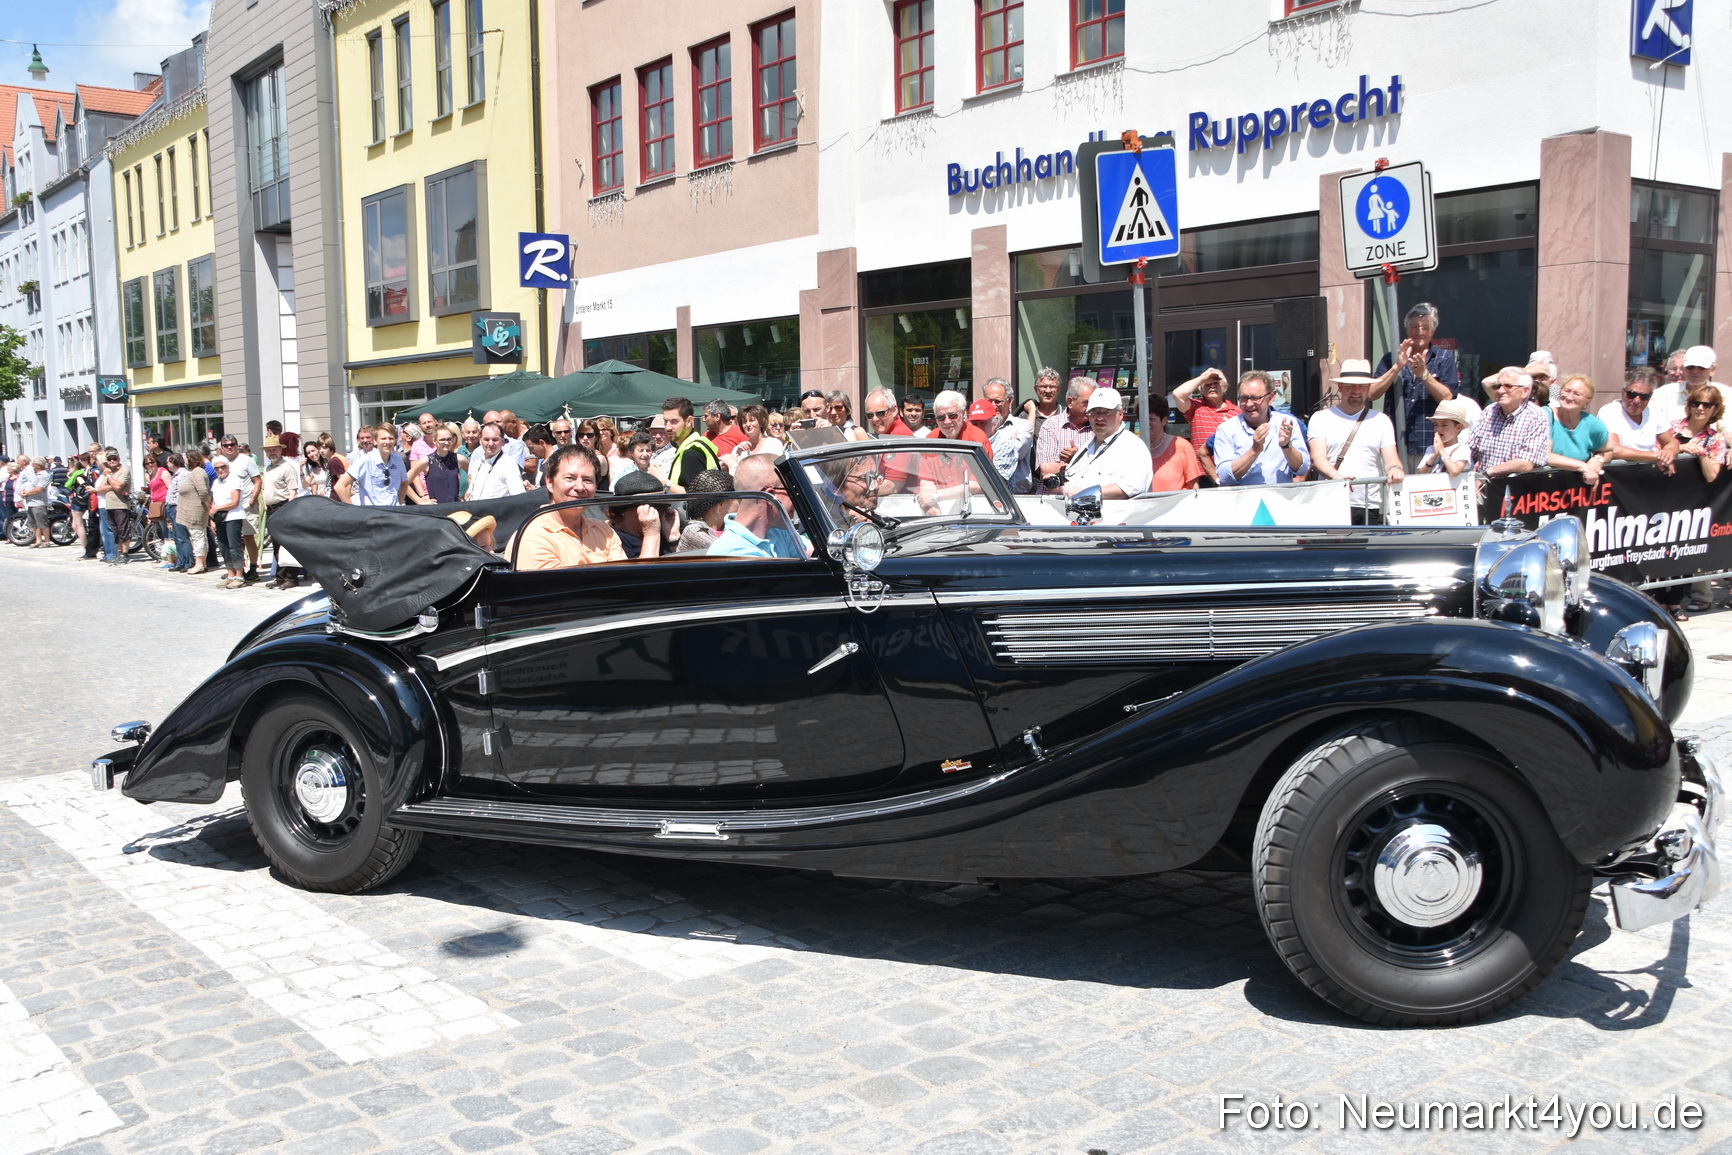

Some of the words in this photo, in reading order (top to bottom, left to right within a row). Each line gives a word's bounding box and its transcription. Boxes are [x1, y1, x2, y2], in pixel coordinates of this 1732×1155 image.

[947, 130, 1176, 196] Buchhan
[1188, 75, 1403, 154] Rupprecht
[1365, 240, 1407, 261] ZONE
[593, 301, 606, 311] Markt
[607, 299, 613, 309] 15
[1500, 482, 1612, 518] FAHRSCHULE
[1538, 506, 1712, 553] hlmann
[1710, 521, 1732, 537] Gmb
[1626, 546, 1666, 564] Freystadt
[1669, 543, 1708, 560] Pyrbaum
